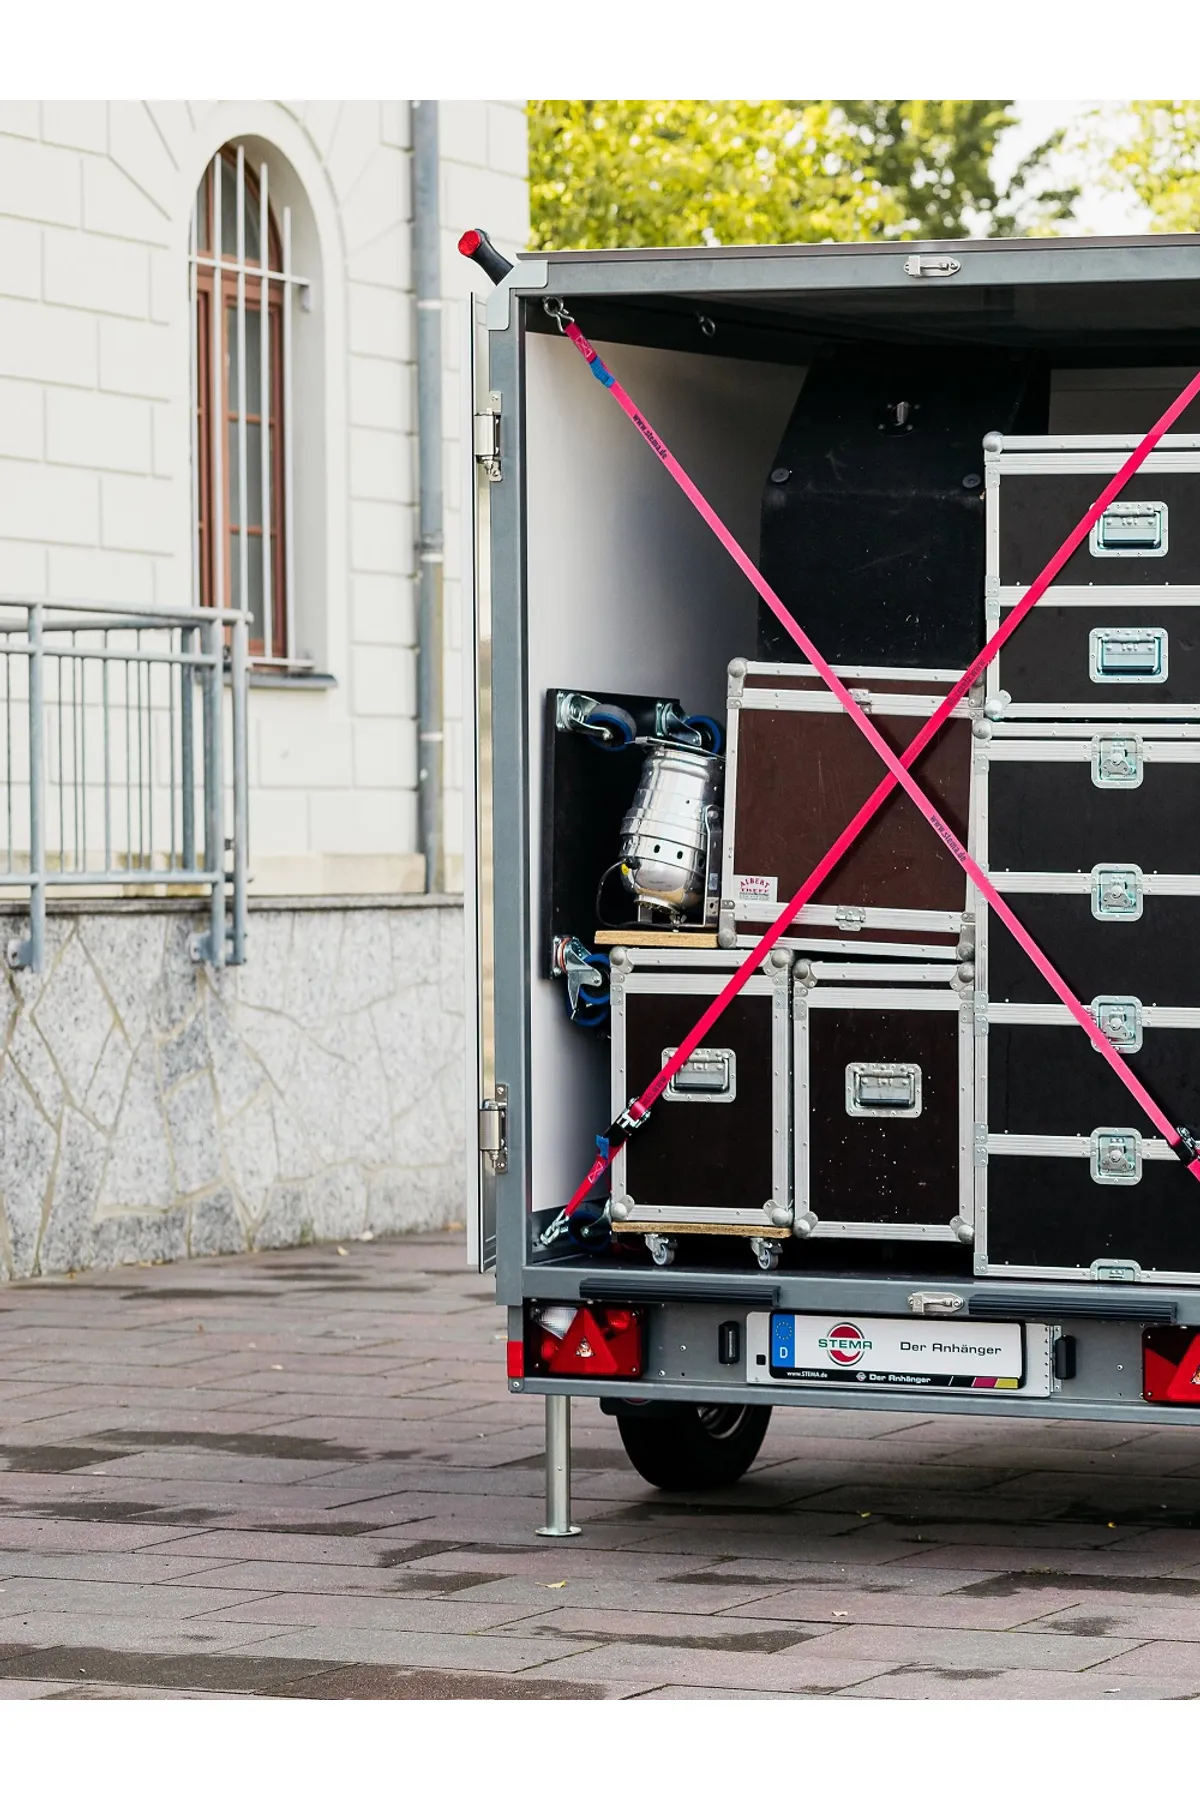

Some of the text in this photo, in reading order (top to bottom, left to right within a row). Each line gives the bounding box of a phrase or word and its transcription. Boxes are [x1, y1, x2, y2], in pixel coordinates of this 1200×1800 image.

[929, 814, 967, 862] www.stema.de
[818, 1338, 873, 1350] STEMA
[900, 1341, 1002, 1357] Der Anhänger
[779, 1346, 789, 1359] D
[868, 1373, 886, 1381] Der
